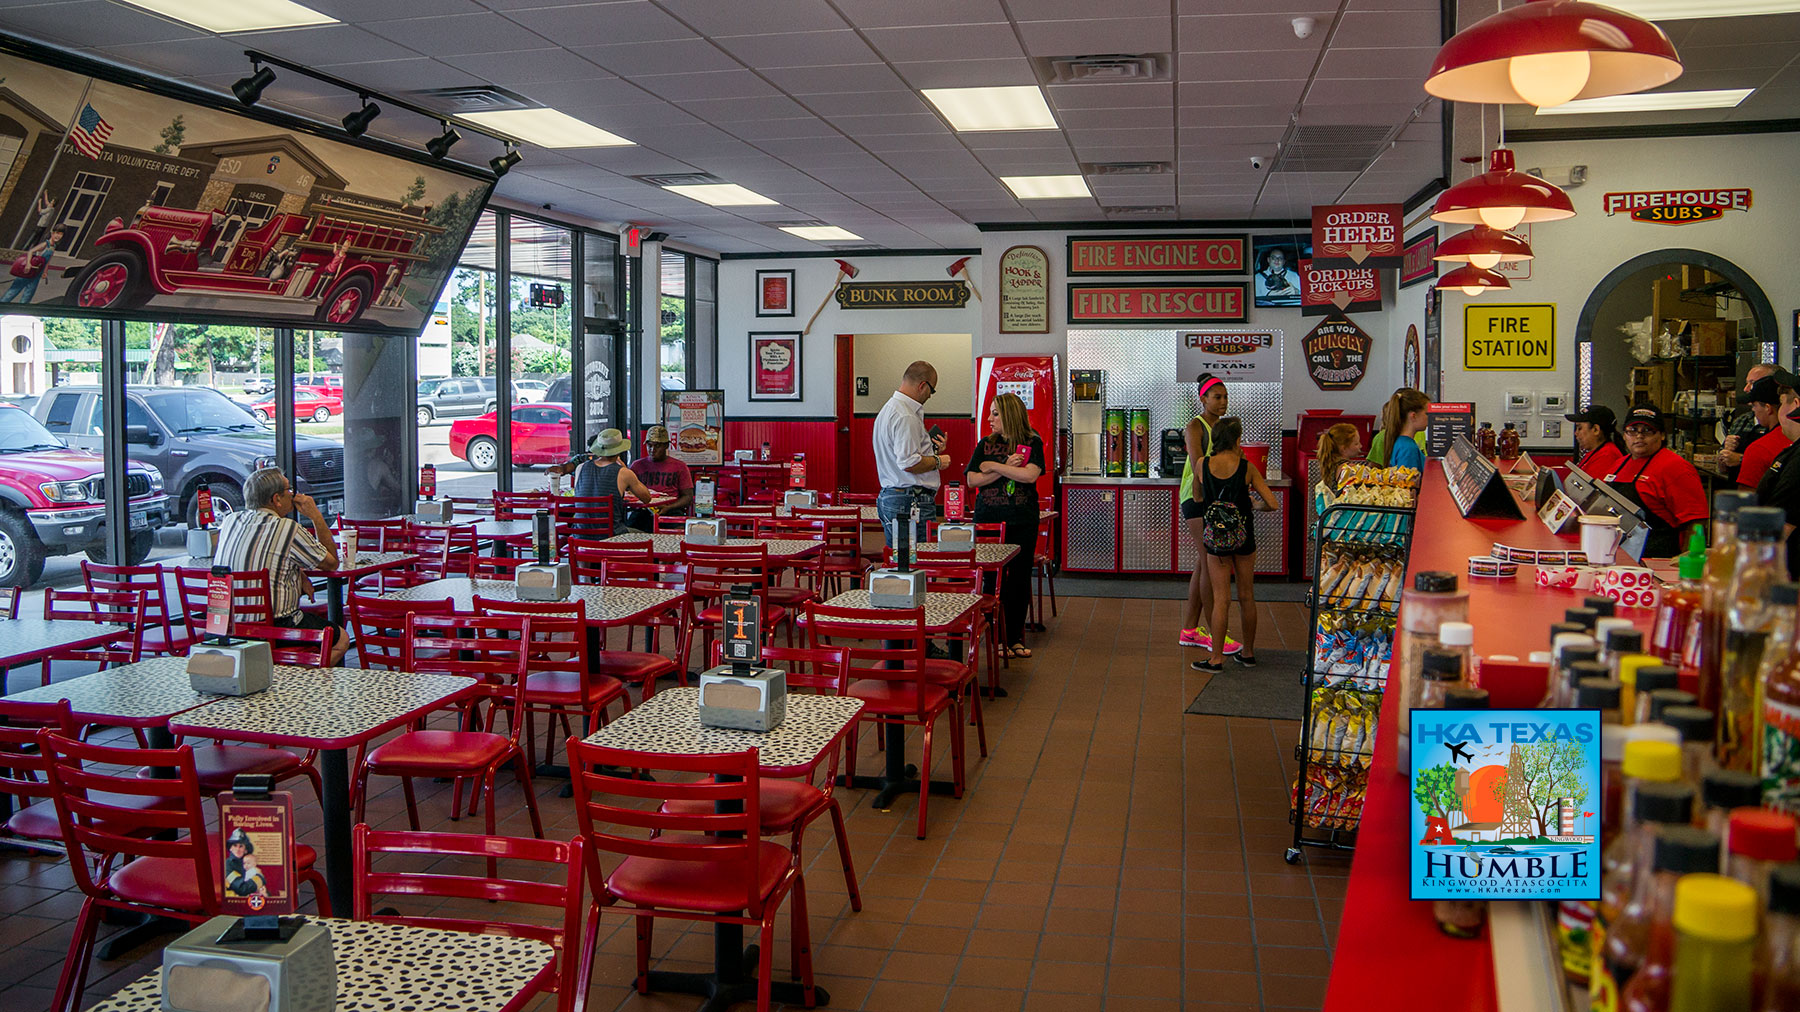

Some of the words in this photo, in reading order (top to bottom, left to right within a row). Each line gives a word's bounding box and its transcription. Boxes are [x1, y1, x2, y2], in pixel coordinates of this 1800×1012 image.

[116, 153, 162, 171] VOLUNTEER
[162, 163, 180, 175] FIRE
[181, 165, 200, 179] DEPT.
[219, 158, 242, 174] ESD
[296, 174, 310, 188] 46
[1607, 191, 1748, 217] FIREHOUSE
[1326, 212, 1390, 226] ORDER
[1652, 207, 1703, 220] SUBS
[1322, 226, 1395, 244] HERE
[1078, 246, 1117, 267] FIRE
[1124, 245, 1199, 266] ENGINE
[1205, 244, 1238, 265] CO.
[1005, 266, 1032, 277] HOOK
[1033, 269, 1042, 279] &
[1499, 262, 1519, 271] LANE
[1307, 268, 1374, 283] ORDER
[1009, 279, 1043, 288] LADDER
[1309, 279, 1374, 294] PICK-UPS
[850, 288, 897, 302] BUNK
[903, 287, 954, 302] ROOM
[1078, 293, 1132, 314] FIRE
[1141, 292, 1237, 313] RESCUE
[1317, 325, 1335, 335] ARE
[1336, 325, 1356, 334] YOU
[1488, 317, 1530, 333] FIRE
[1187, 335, 1271, 349] FIREHOUSE
[1213, 344, 1244, 353] SUBS
[1308, 334, 1366, 355] HUNGRY
[1472, 340, 1548, 357] STATION
[1312, 355, 1331, 363] CALL
[1014, 370, 1034, 378] Coca-Cola
[733, 606, 747, 639] 1
[228, 815, 244, 823] Fully
